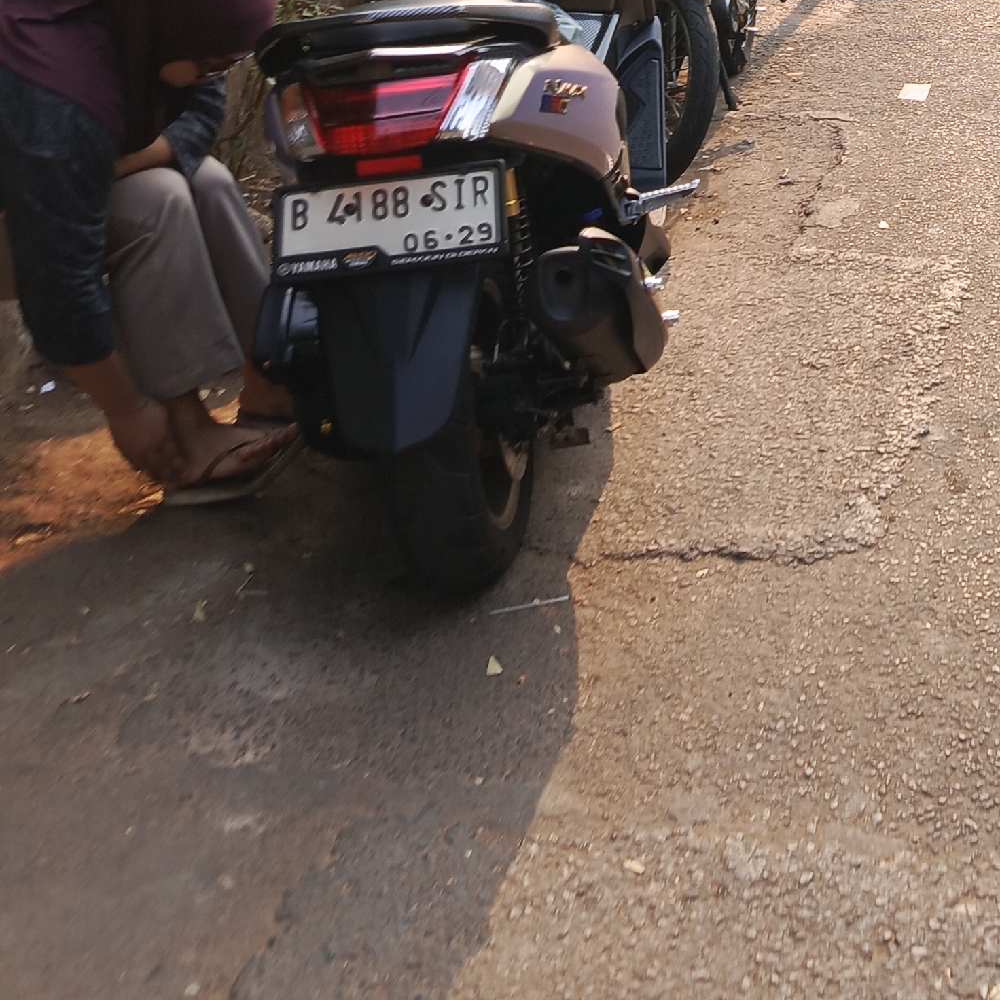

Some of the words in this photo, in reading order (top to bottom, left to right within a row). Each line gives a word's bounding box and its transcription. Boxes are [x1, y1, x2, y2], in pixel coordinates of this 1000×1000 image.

[290, 198, 309, 231] B
[326, 185, 410, 226] 4188
[429, 175, 490, 212] SIR
[290, 258, 339, 274] YAMAHA
